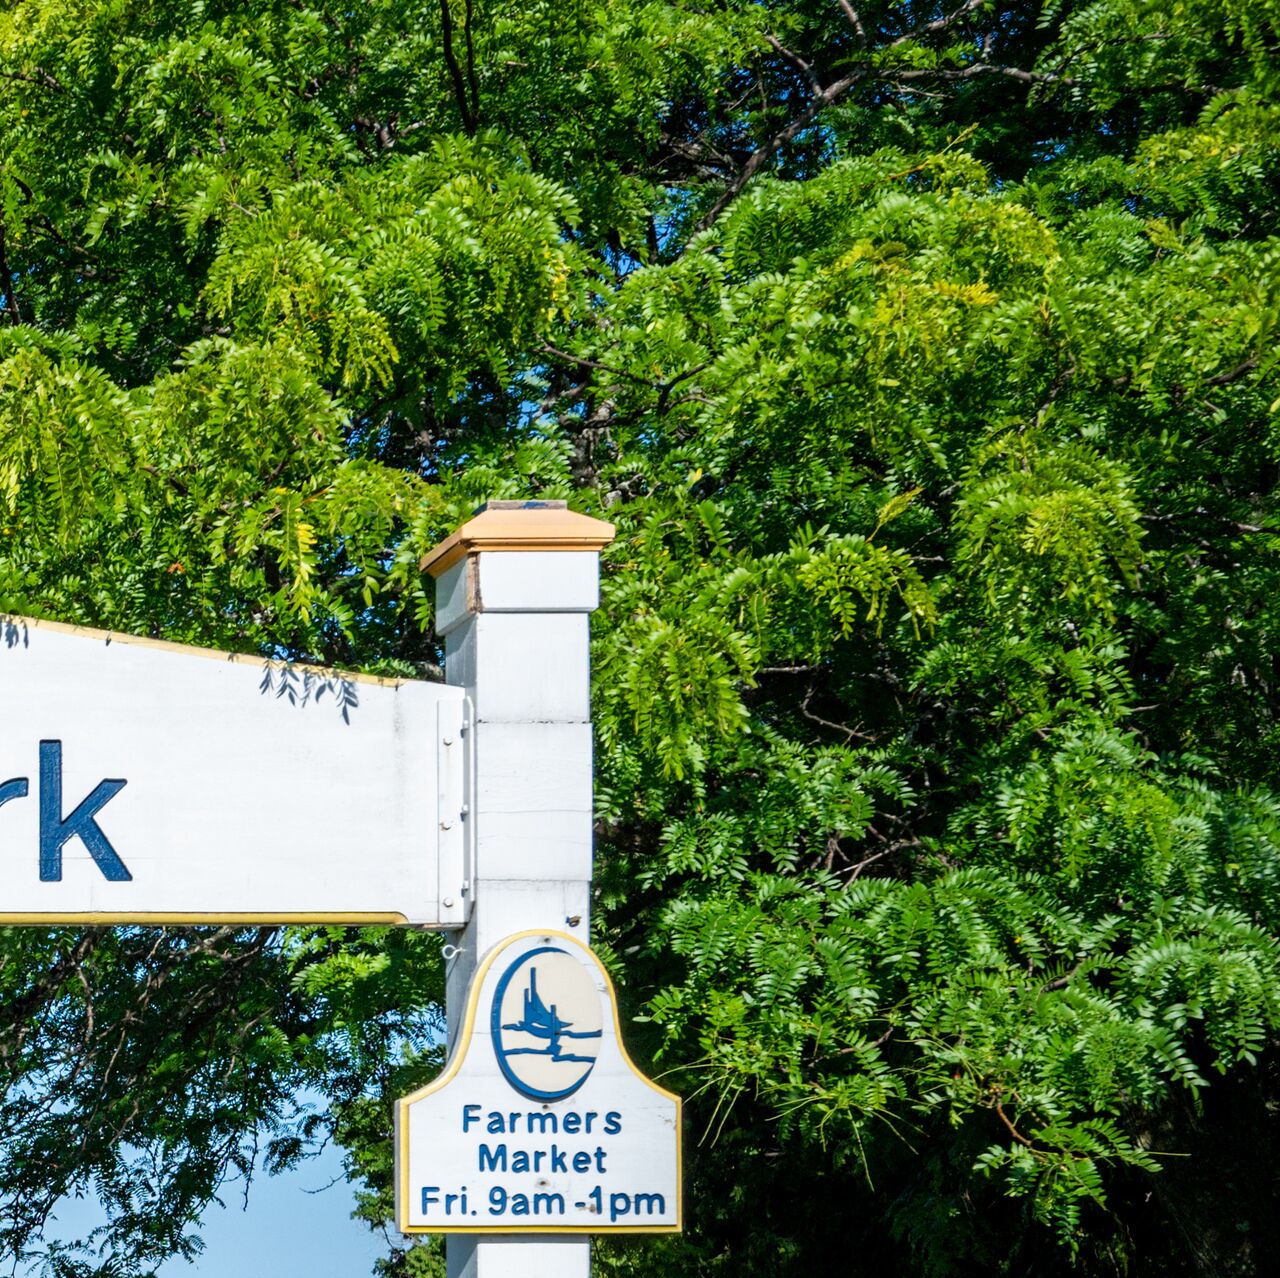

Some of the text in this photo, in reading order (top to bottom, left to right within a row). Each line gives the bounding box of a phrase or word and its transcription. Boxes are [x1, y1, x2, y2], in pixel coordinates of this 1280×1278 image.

[462, 1104, 622, 1135] Farmers
[478, 1143, 608, 1174] Market
[421, 1186, 477, 1216] Fri.
